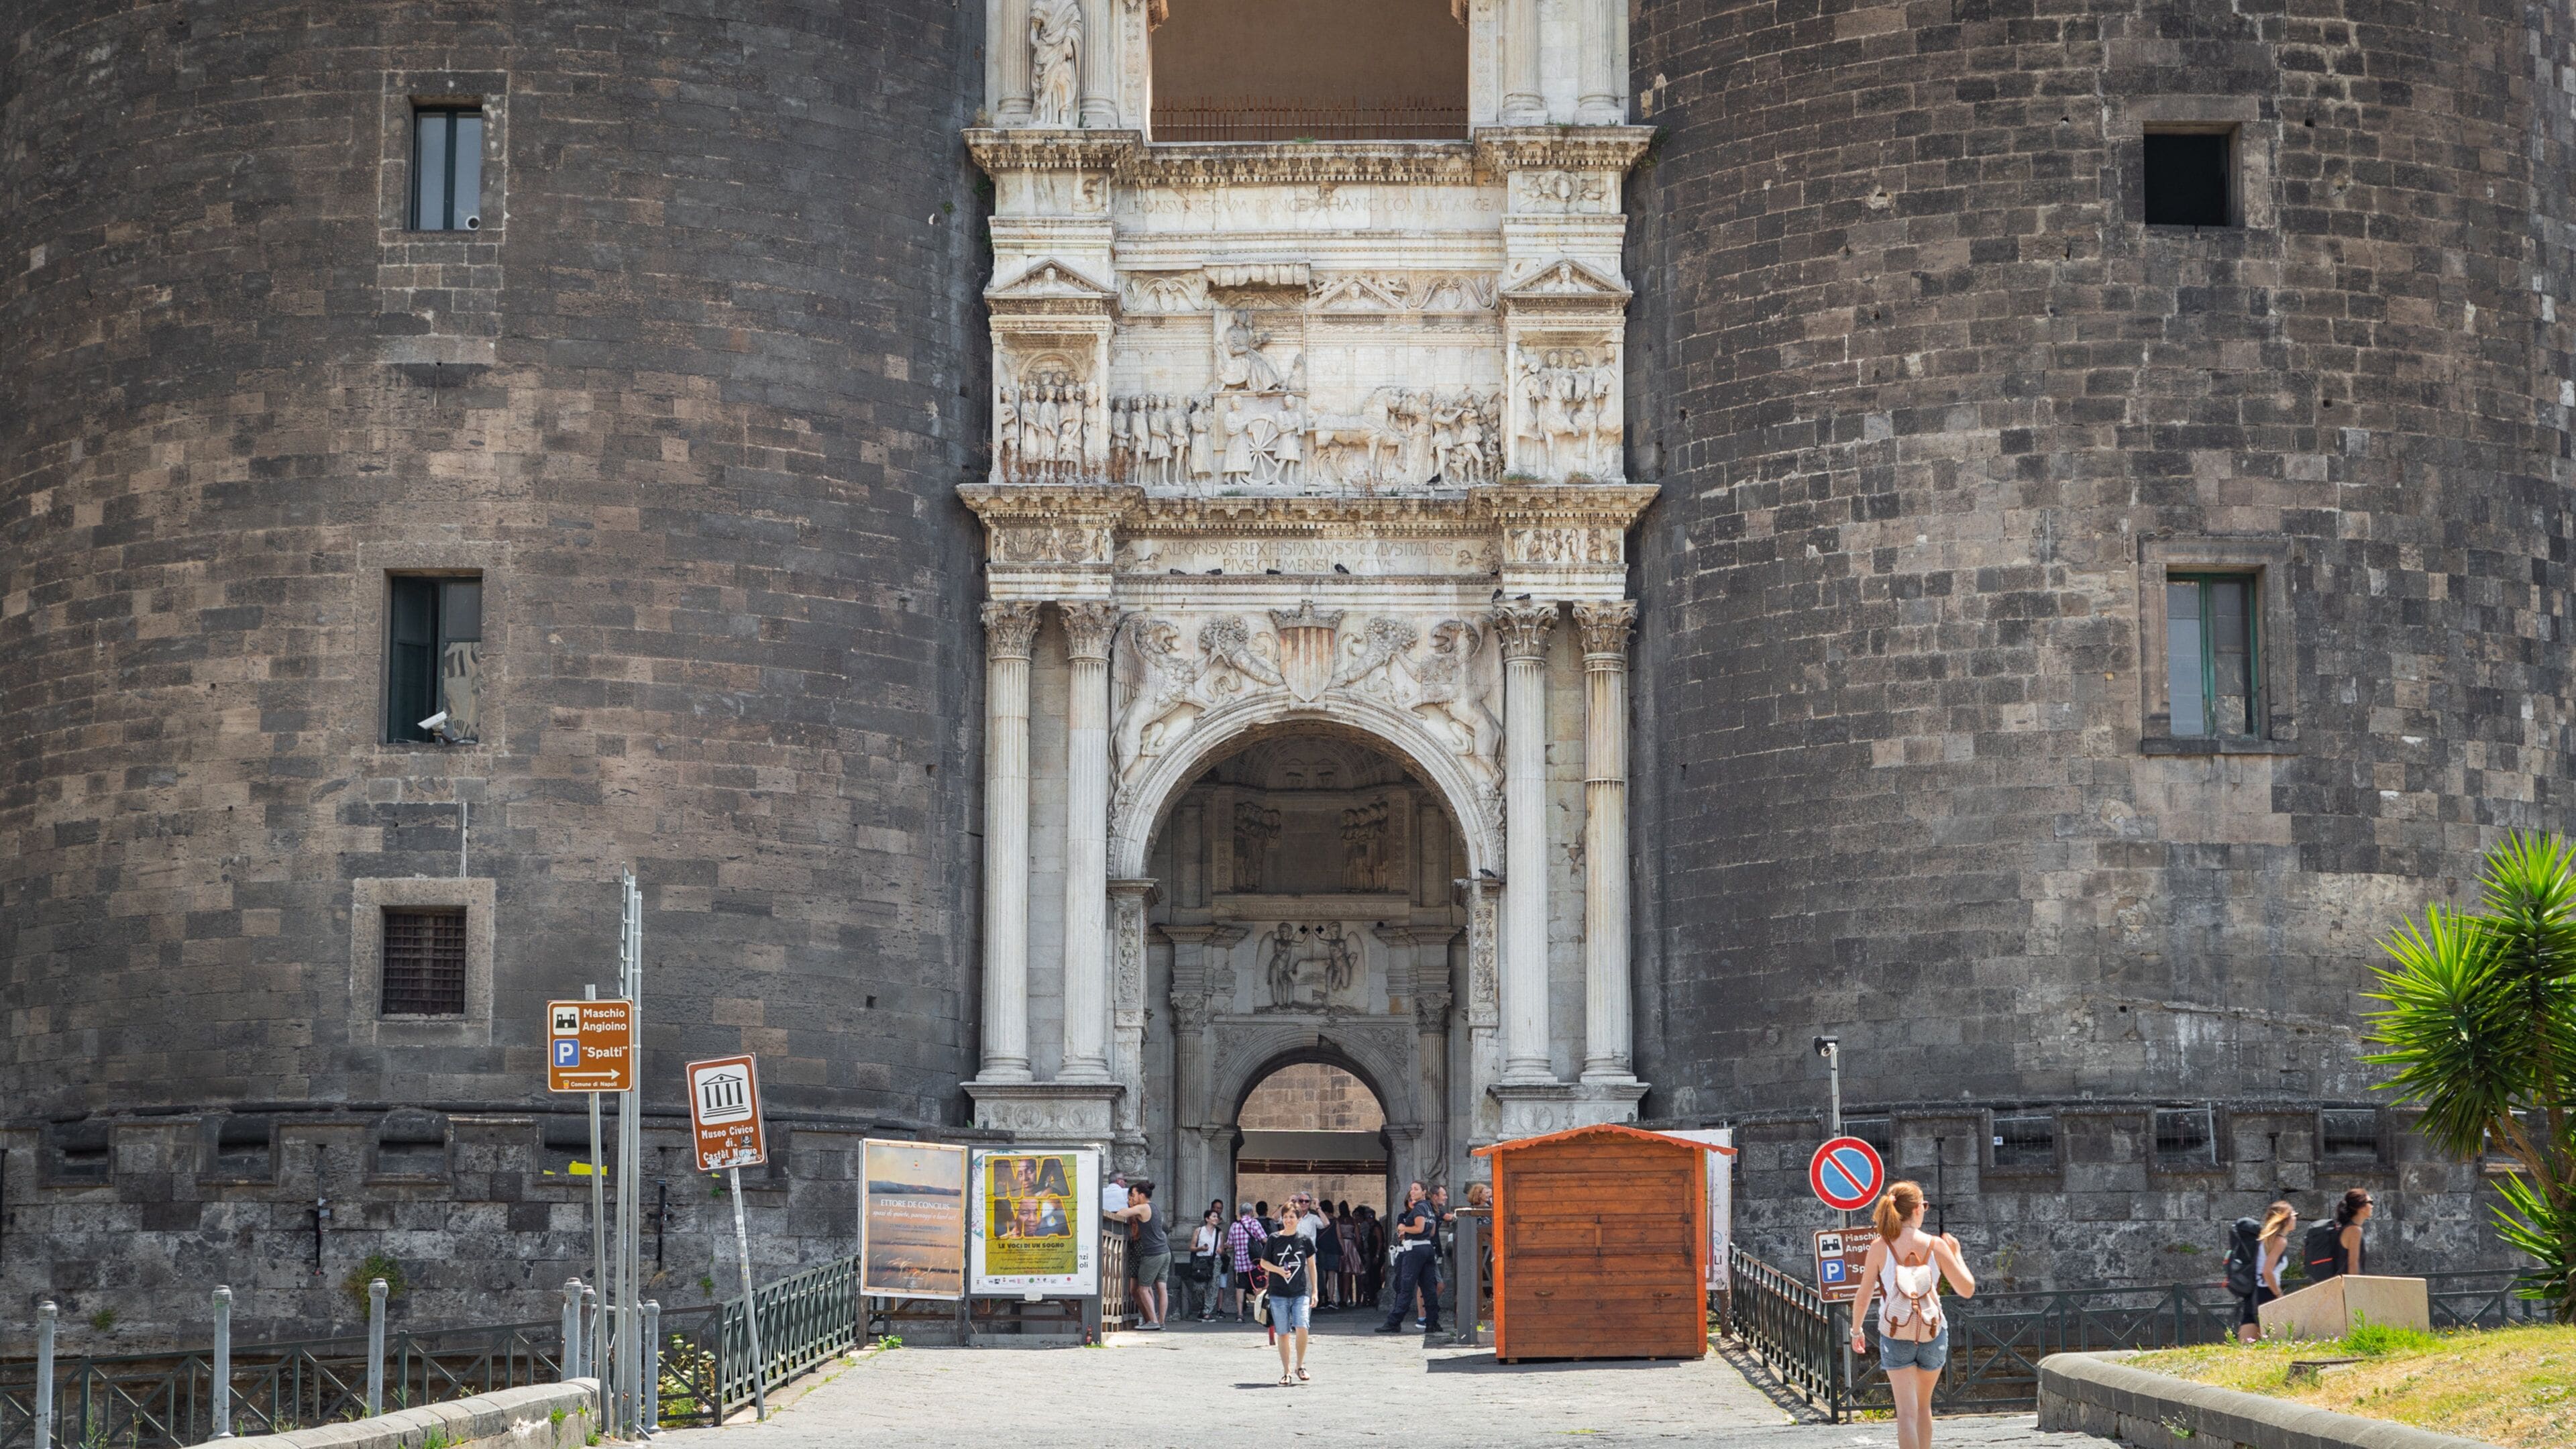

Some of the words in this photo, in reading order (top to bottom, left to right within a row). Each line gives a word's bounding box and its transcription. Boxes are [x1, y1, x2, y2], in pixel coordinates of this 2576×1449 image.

[1160, 541, 1238, 556] ALFONSVS
[1240, 541, 1267, 556] REX
[1223, 558, 1254, 573] PIVS
[1256, 559, 1325, 573] CLEMENS
[583, 1008, 625, 1018] Maschio
[582, 1022, 627, 1032] Angioino
[559, 1042, 574, 1063] P
[701, 1129, 727, 1139] Museo
[729, 1125, 754, 1136] Civico
[880, 1199, 906, 1208] ETTORE
[907, 1200, 917, 1208] DE
[1845, 1232, 1882, 1242] Maschio
[1845, 1244, 1871, 1253] Angio
[1714, 1254, 1722, 1265] LI
[1826, 1263, 1839, 1279] P
